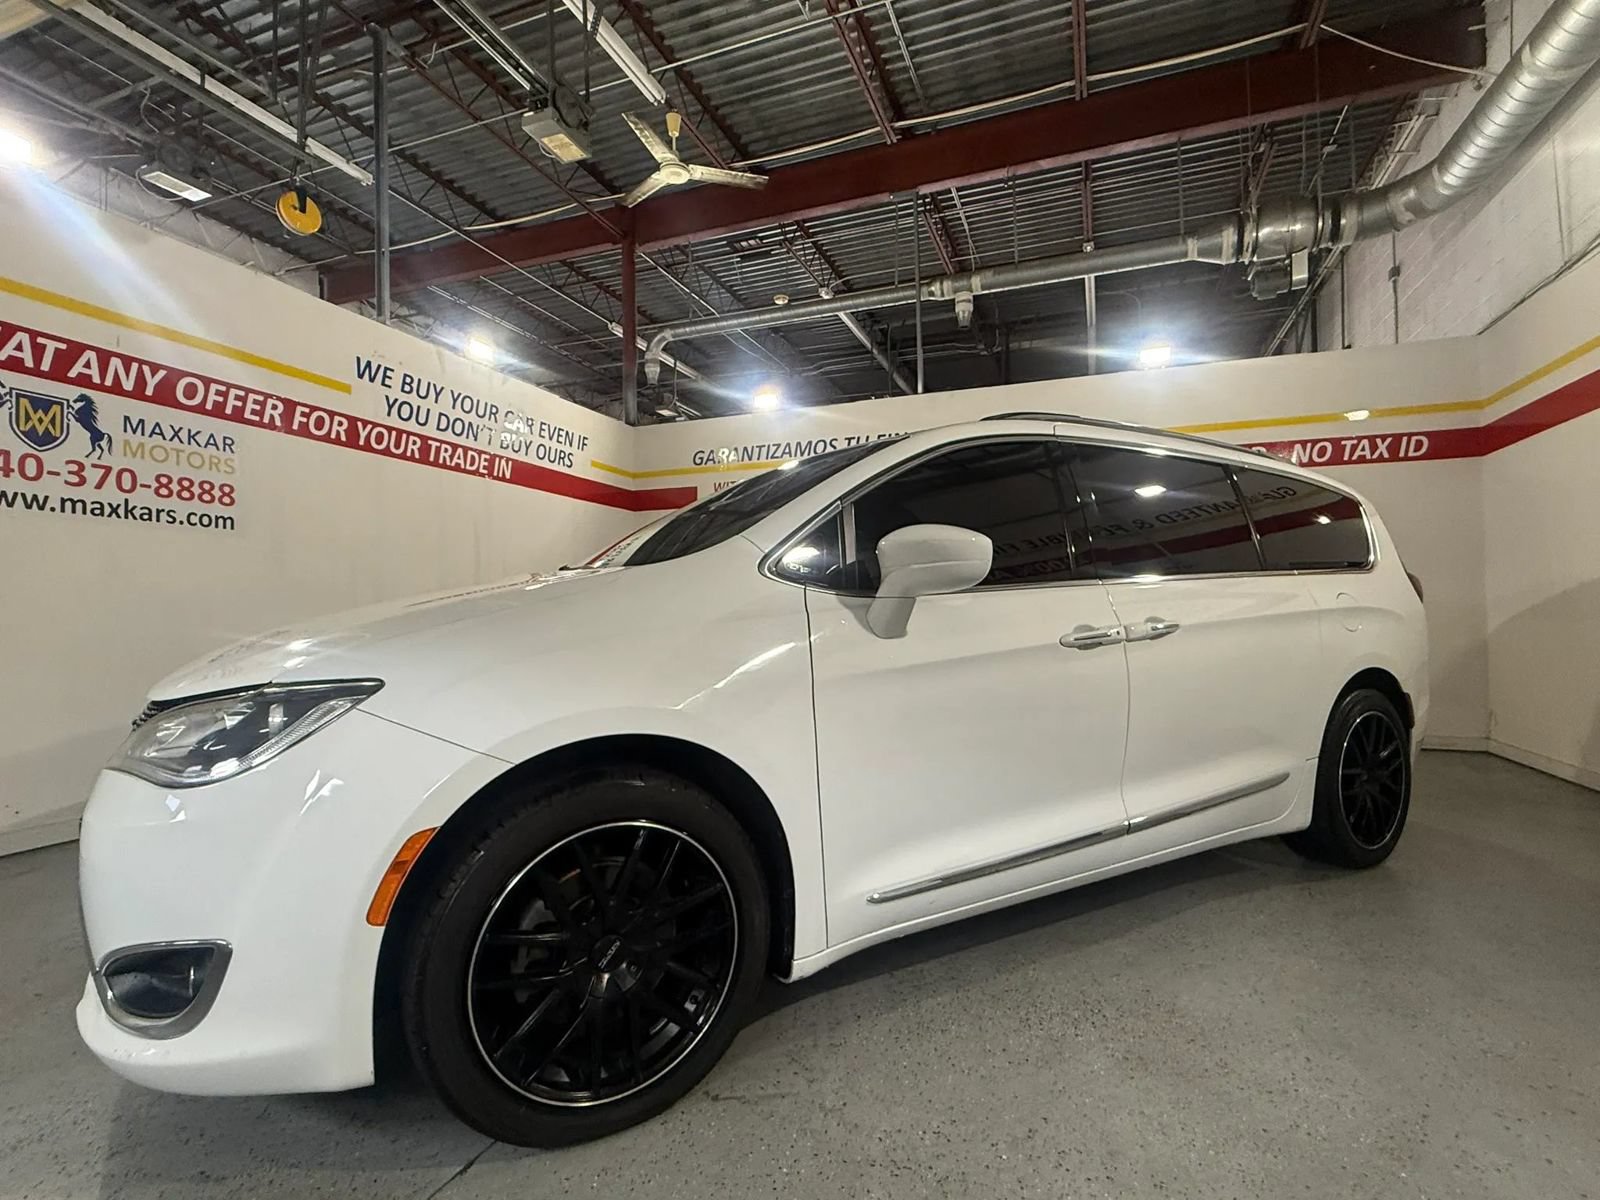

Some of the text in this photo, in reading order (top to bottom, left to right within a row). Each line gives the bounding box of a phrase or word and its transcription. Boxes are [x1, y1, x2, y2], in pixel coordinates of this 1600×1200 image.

[0, 328, 513, 480] AT ANY OFFER FOR YOUR TRADE IN
[356, 355, 589, 452] WE BUY YOUR CAR EVEN IF
[123, 415, 236, 454] MAXKAR
[385, 394, 574, 469] YOU DON'T BUY OURS
[692, 438, 839, 467] GARANTIZAMOS
[1292, 435, 1430, 463] NO TAX ID
[0, 448, 237, 507] 40-370-8888
[123, 439, 236, 475] MOTORS
